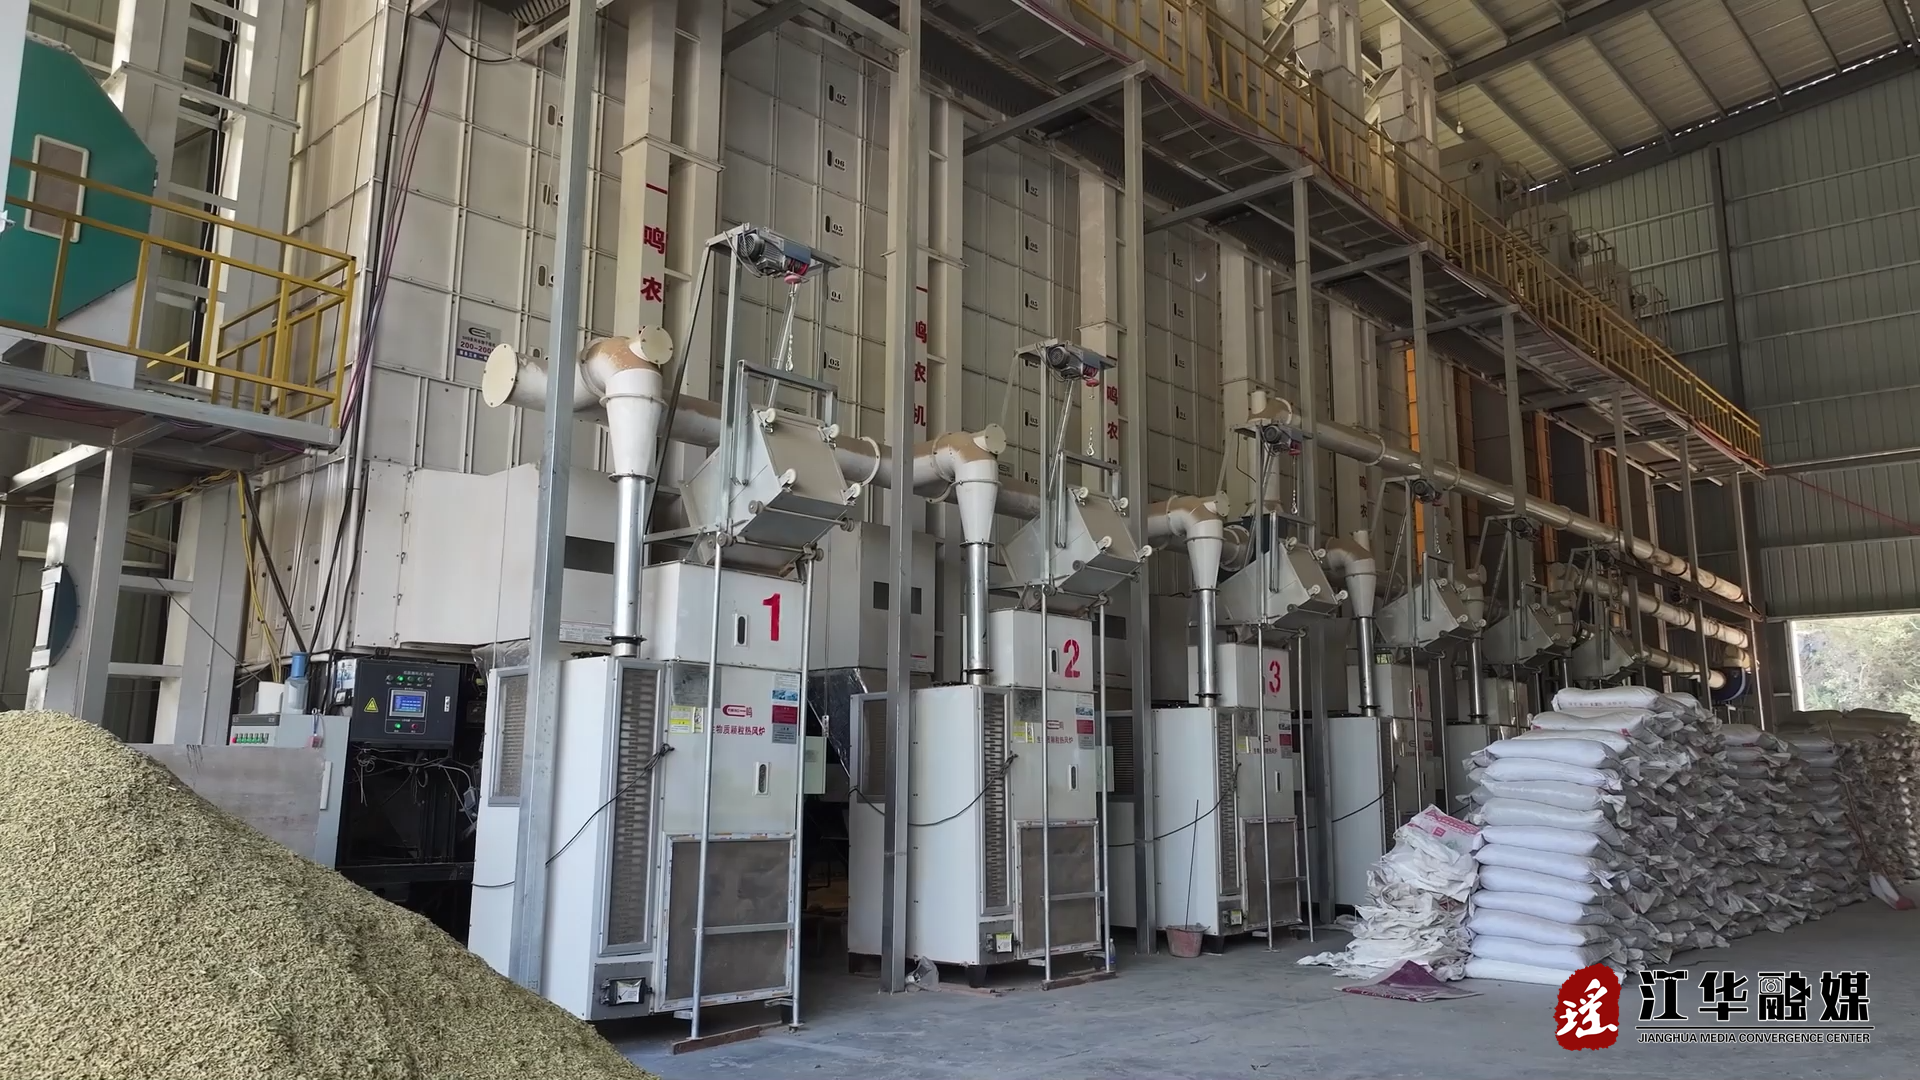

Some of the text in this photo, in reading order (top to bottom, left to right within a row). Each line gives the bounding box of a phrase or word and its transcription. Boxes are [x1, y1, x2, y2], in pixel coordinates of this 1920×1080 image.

[836, 93, 846, 102] 07
[639, 182, 668, 334] 一鸣农
[829, 357, 840, 368] 03
[762, 593, 781, 642] 1
[1063, 639, 1081, 678] 2
[1269, 660, 1281, 693] 3
